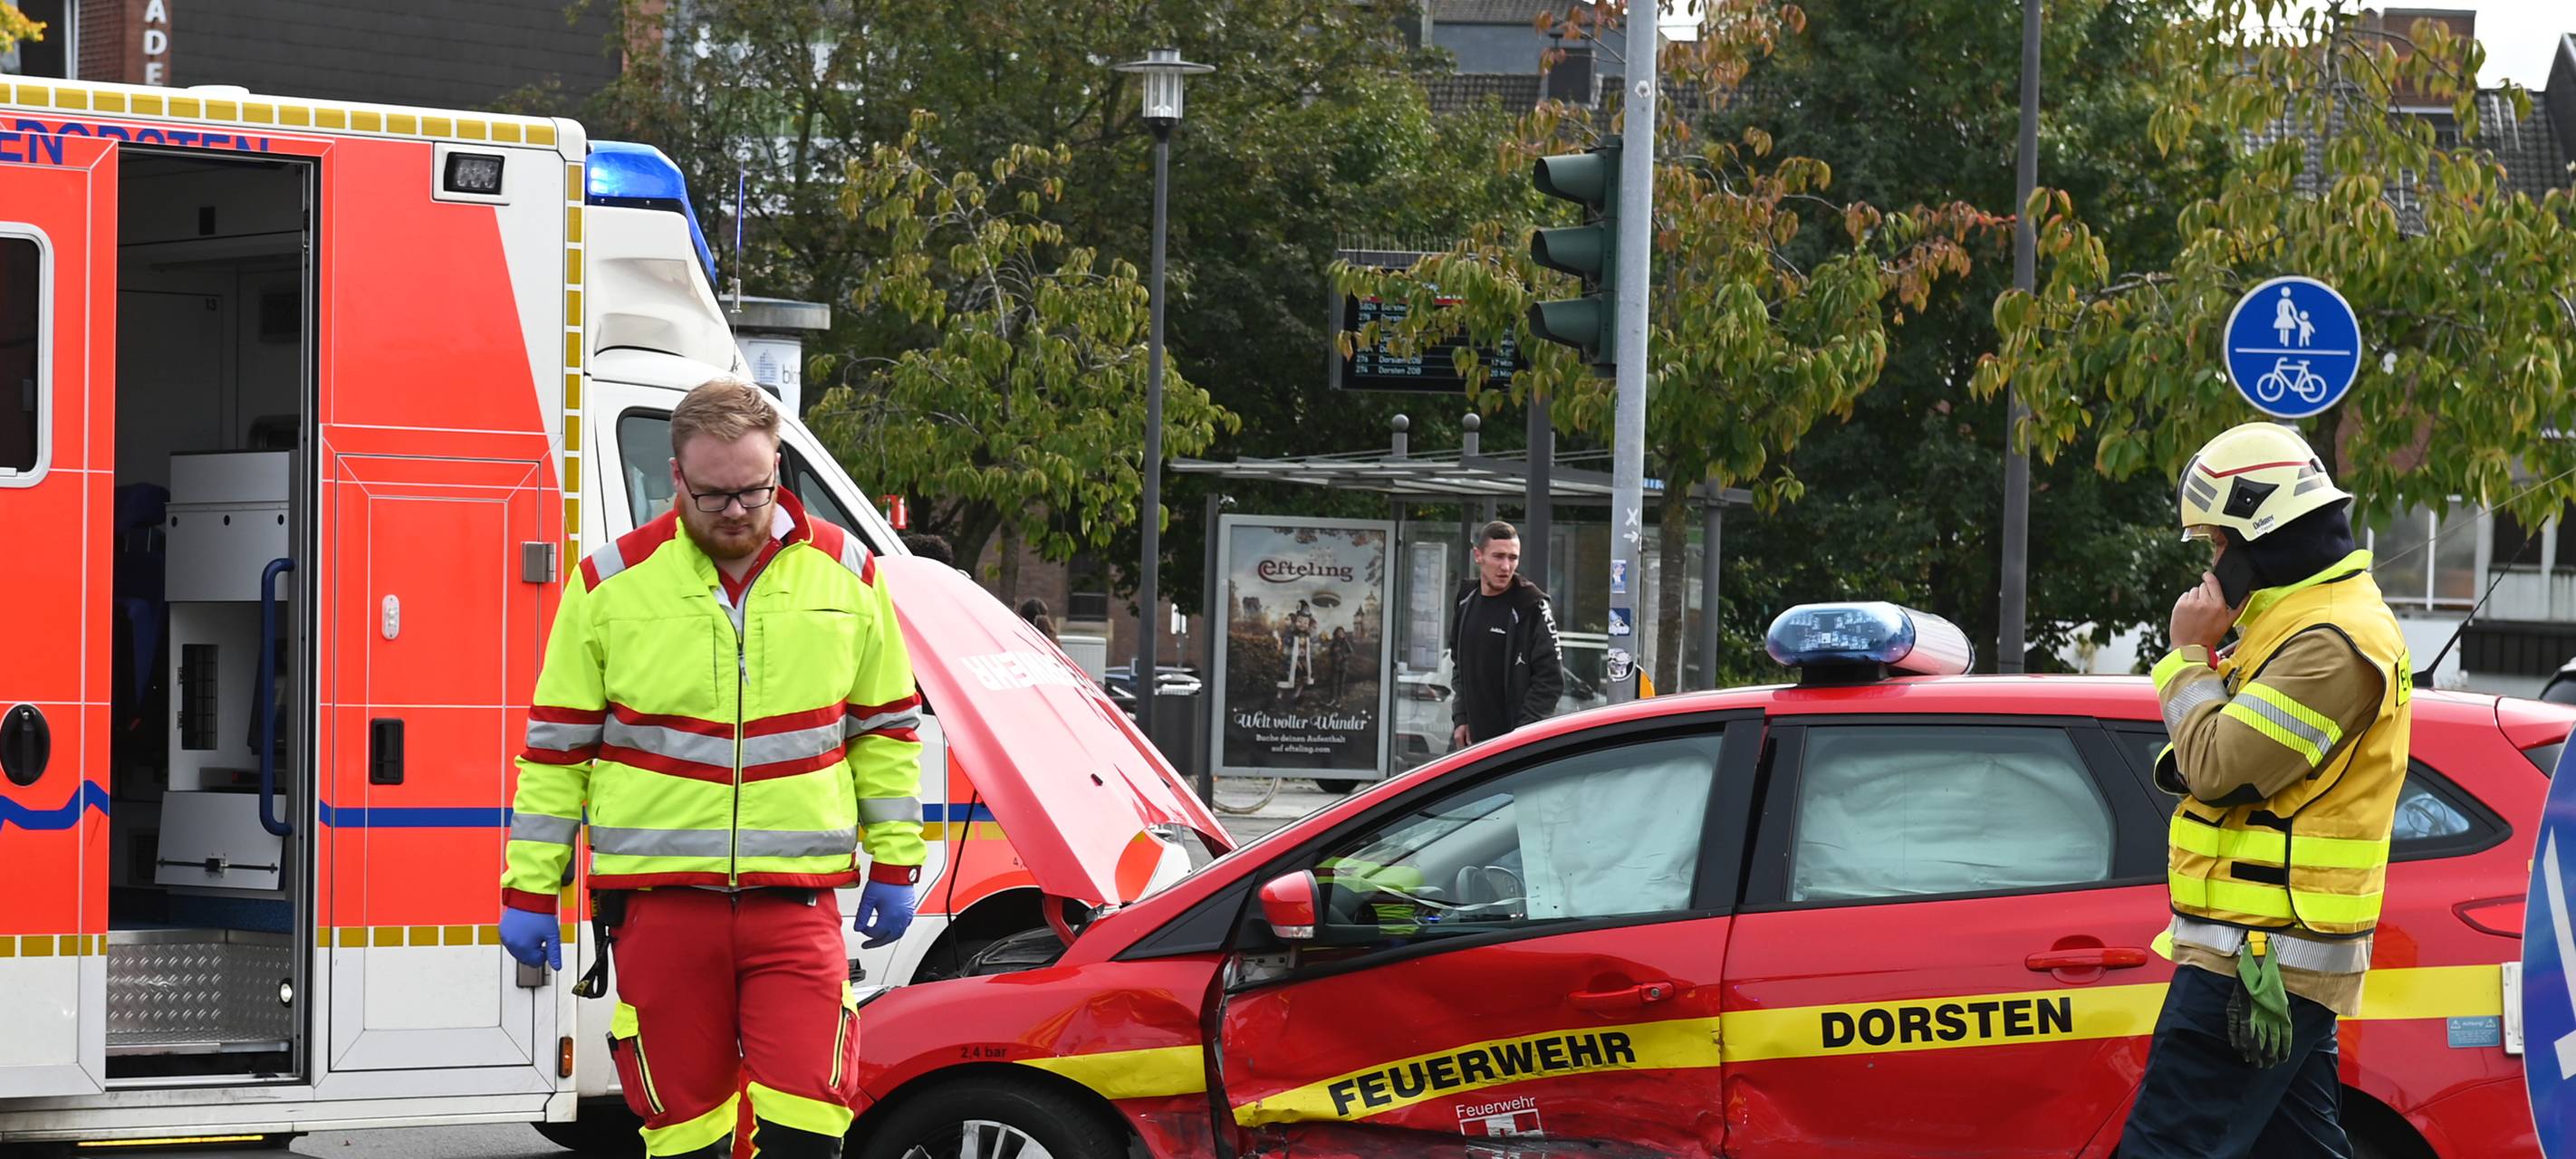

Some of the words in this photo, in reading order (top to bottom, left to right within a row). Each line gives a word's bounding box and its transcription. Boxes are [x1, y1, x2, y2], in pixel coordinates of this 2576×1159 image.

[1234, 711, 1272, 729] Welt
[1274, 714, 1309, 729] voller
[1311, 713, 1367, 731] Wunder
[1255, 733, 1279, 742] Buche
[1280, 733, 1306, 742] deinen
[1307, 734, 1346, 743] Aufenthalt
[1284, 744, 1331, 754] efteling.com
[1821, 996, 2073, 1049] DORSTEN
[960, 1046, 980, 1060] 2,4
[985, 1046, 1007, 1058] bar
[1328, 1031, 1636, 1116] FEUERWEHR
[1456, 1096, 1536, 1119] Feuerwehr
